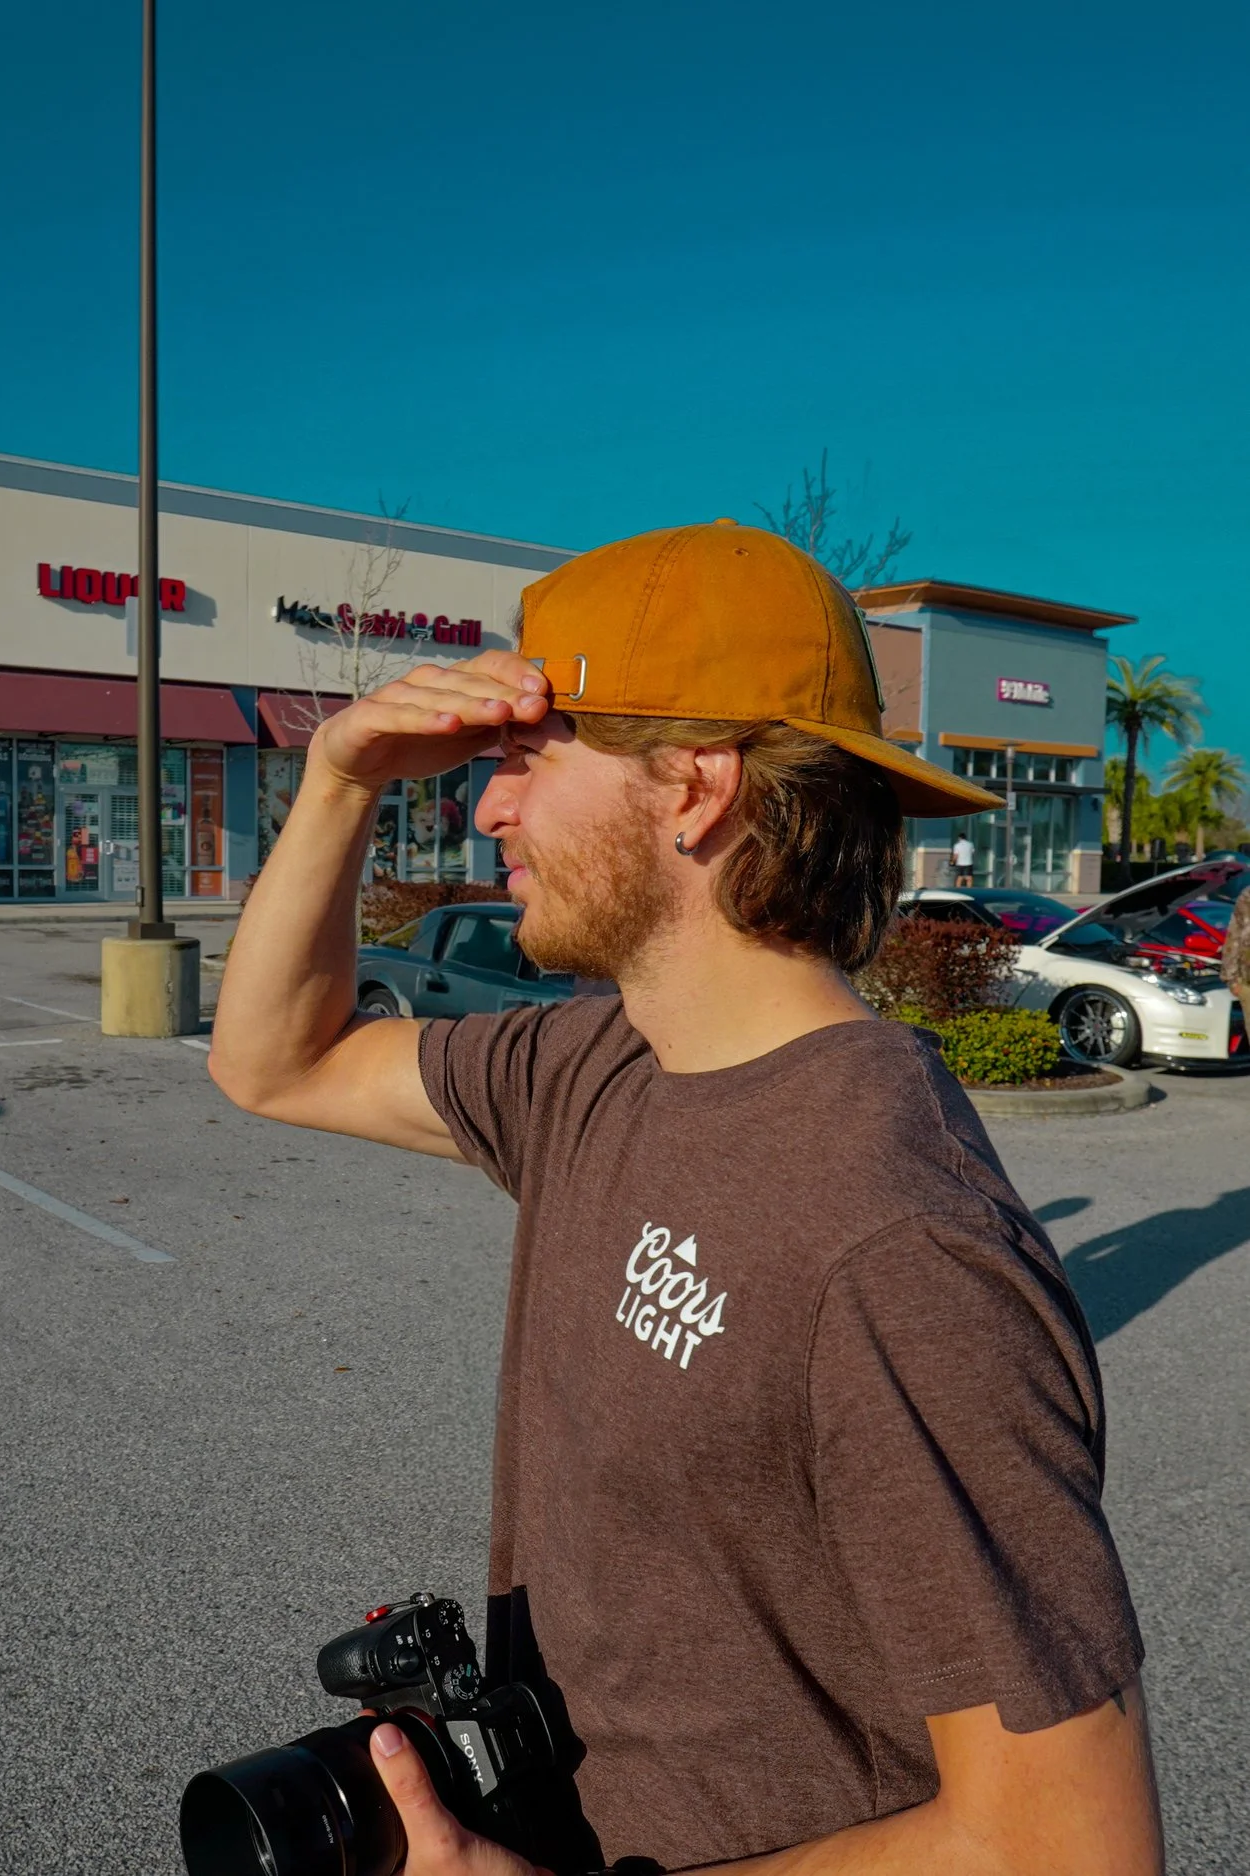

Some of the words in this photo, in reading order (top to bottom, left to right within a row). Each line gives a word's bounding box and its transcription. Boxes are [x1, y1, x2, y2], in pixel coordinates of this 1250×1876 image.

[38, 563, 186, 611] LIQUR
[434, 615, 482, 646] Grill
[625, 1221, 728, 1336] Coors
[615, 1286, 703, 1370] LIGHT
[459, 1732, 484, 1784] SONY
